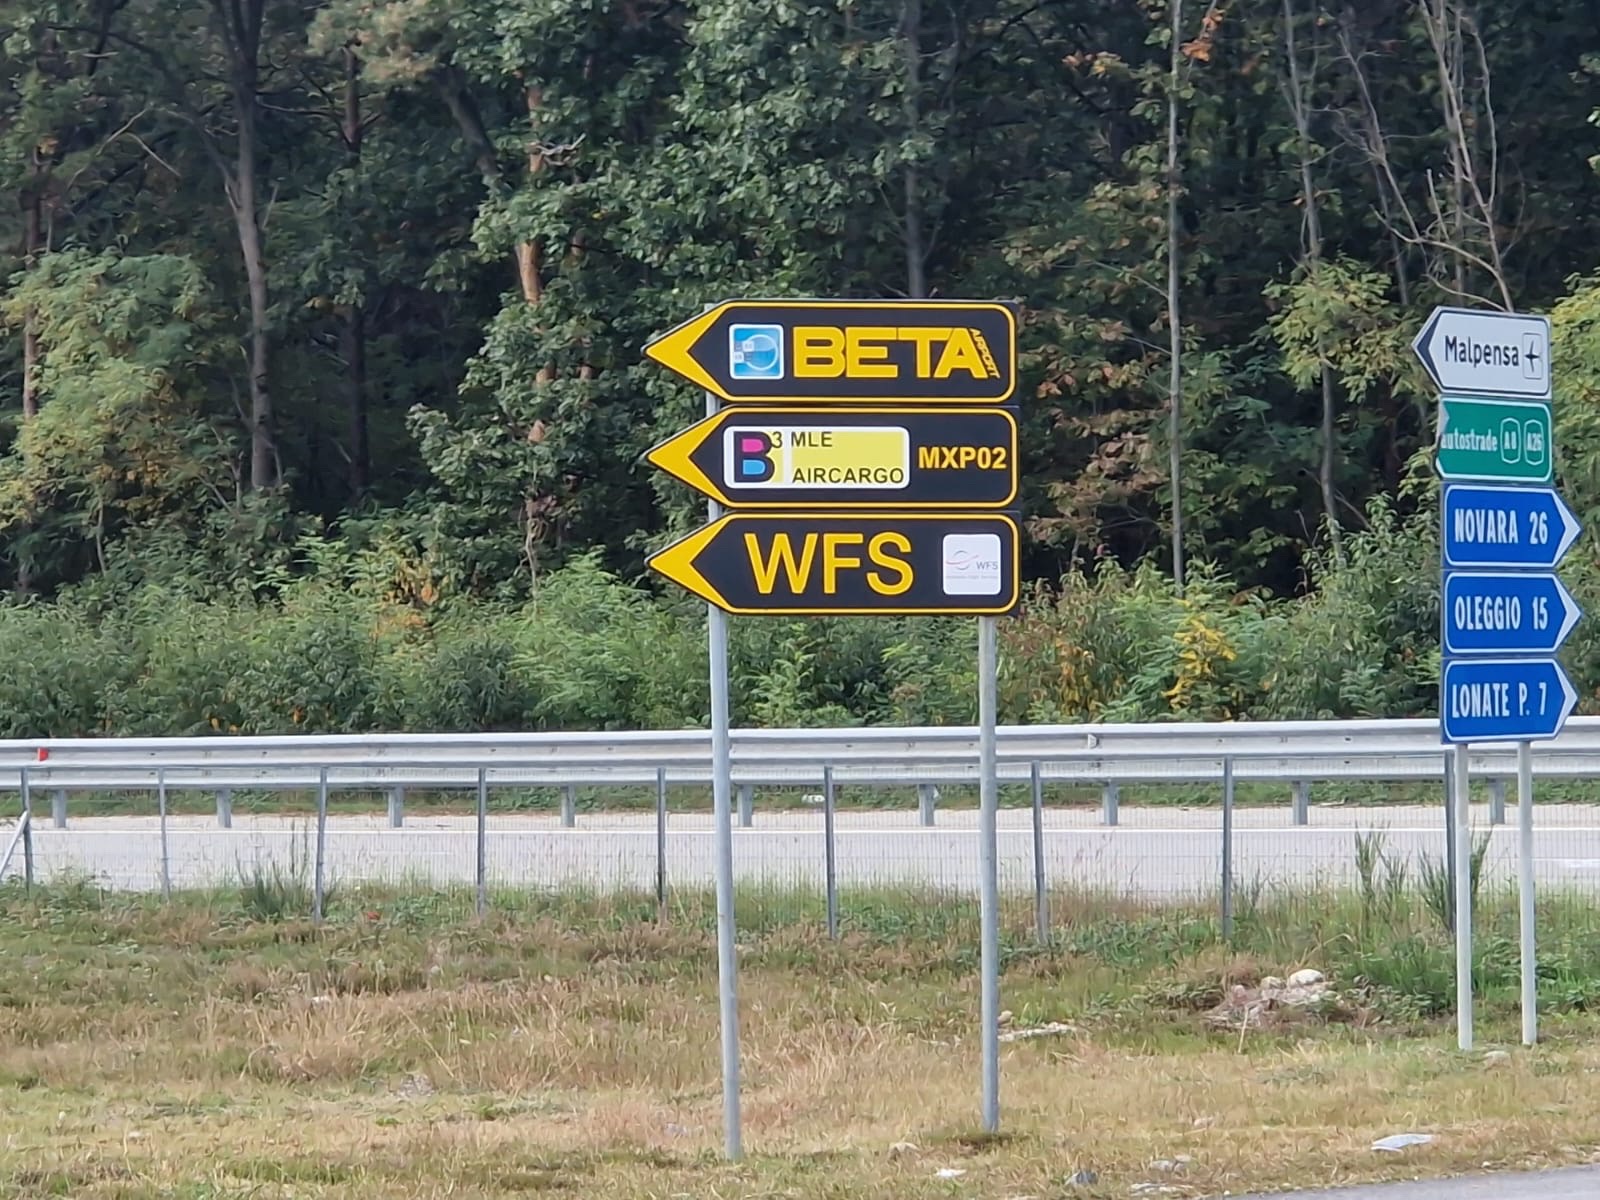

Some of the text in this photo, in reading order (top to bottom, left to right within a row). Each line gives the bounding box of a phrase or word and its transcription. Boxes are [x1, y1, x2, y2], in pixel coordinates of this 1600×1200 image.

[793, 327, 988, 379] BETA
[1444, 335, 1520, 368] Malpensa
[791, 431, 833, 448] MLE
[1440, 428, 1498, 452] autostrade
[918, 446, 1007, 470] MXP02
[792, 467, 904, 484] AIRCARGO
[1454, 508, 1549, 545] NOVARA 26
[744, 531, 914, 596] WFS
[976, 560, 999, 571] WFS
[1454, 595, 1549, 631] OLEGGIO 15
[1452, 681, 1548, 718] LONATE P. 7
